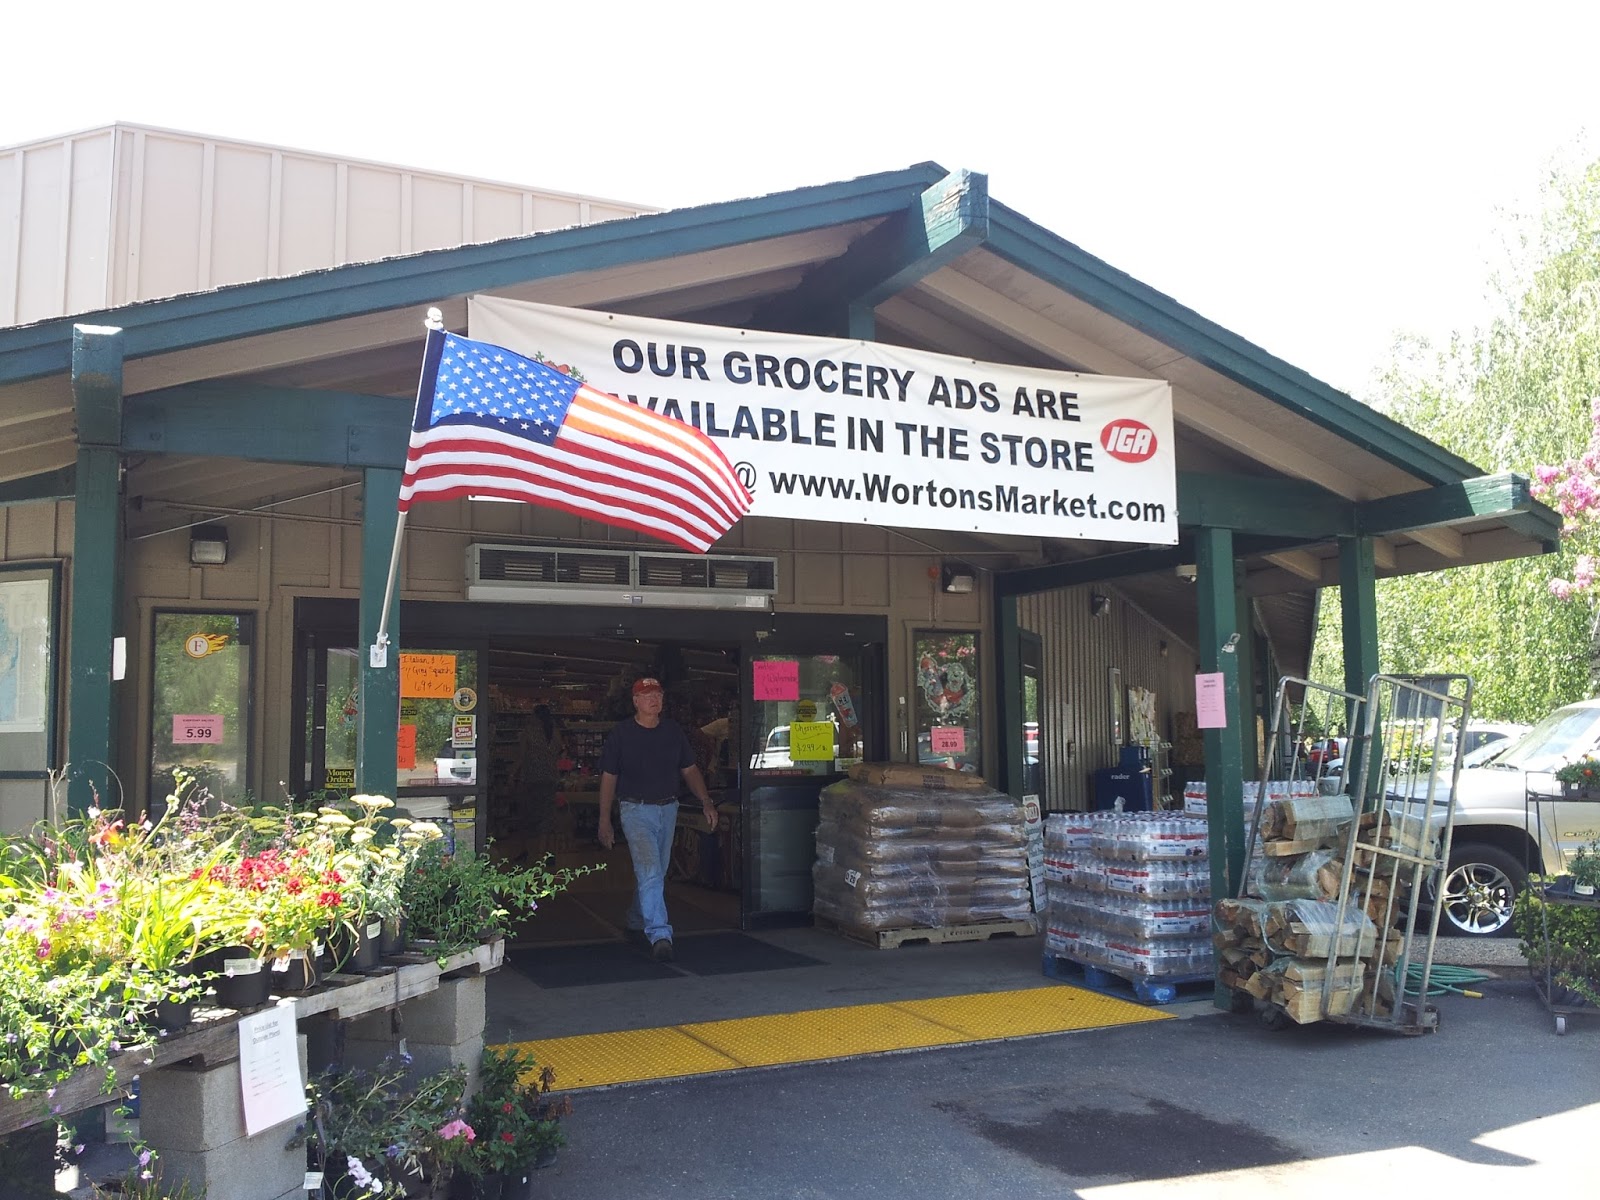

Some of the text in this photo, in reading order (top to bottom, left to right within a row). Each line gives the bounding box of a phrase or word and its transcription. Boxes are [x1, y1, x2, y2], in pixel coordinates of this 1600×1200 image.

[612, 339, 1081, 422] OUR GROCERY ADS ARE
[607, 393, 1095, 472] AILABLE IN THE STORE
[1106, 426, 1153, 455] IGA
[768, 471, 1166, 523] www.WortonsMarket.com
[186, 729, 212, 738] 5.99
[327, 769, 352, 777] Money
